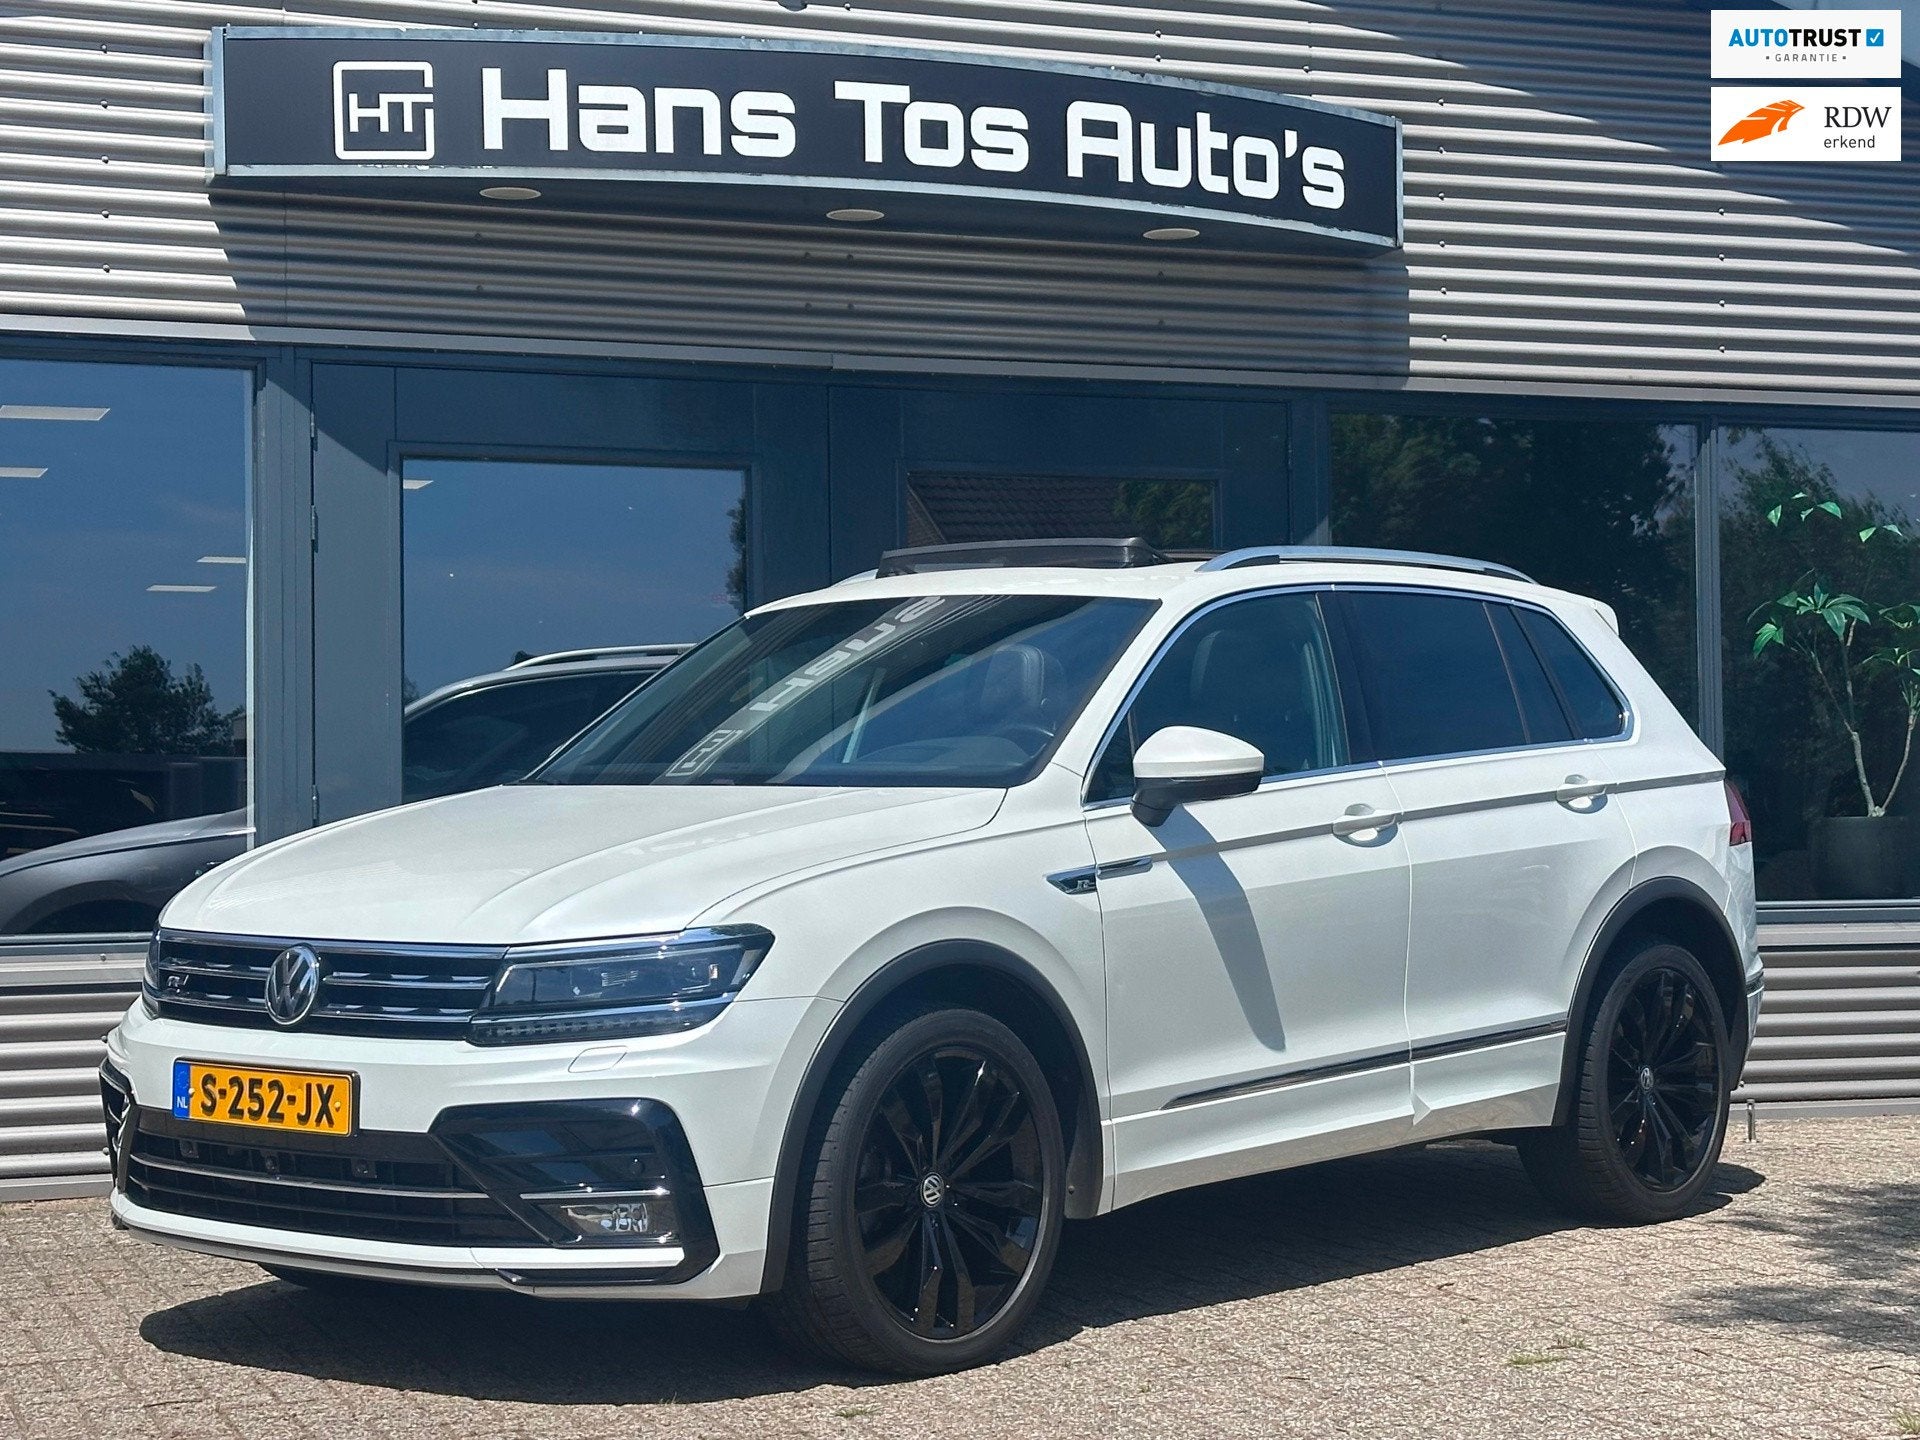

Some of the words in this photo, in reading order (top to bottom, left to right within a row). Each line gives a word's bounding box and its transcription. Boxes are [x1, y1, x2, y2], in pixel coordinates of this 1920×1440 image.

[482, 67, 796, 158] Hans
[834, 81, 1029, 172] Tos
[1066, 100, 1345, 209] Auto's
[176, 1096, 188, 1108] NL
[200, 1073, 335, 1128] S-252-JX
